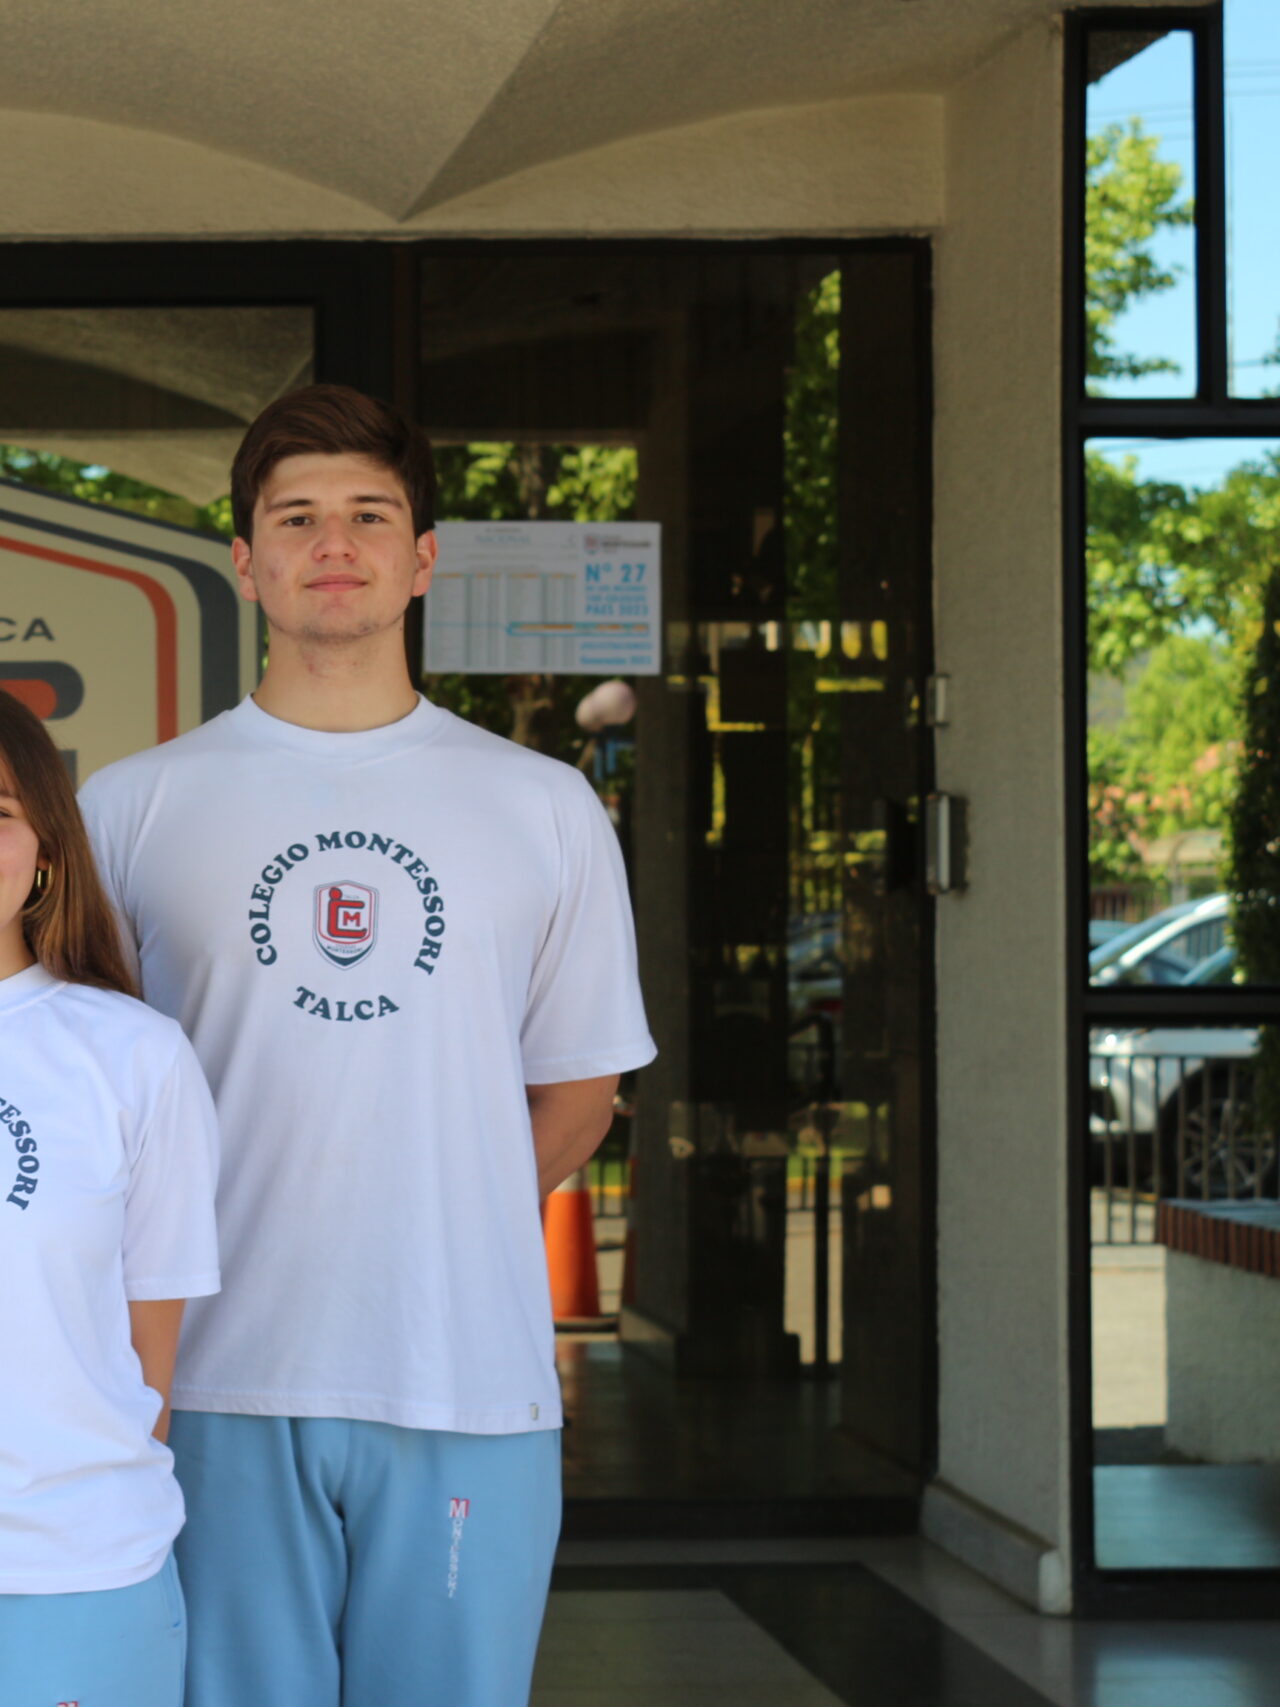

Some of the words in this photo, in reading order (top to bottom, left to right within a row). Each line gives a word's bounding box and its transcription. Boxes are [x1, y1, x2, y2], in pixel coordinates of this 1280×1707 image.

[621, 563, 646, 583] 27
[249, 843, 309, 966] COLEGIO
[315, 830, 445, 975] MONTESSORI
[293, 986, 400, 1022] TALCA
